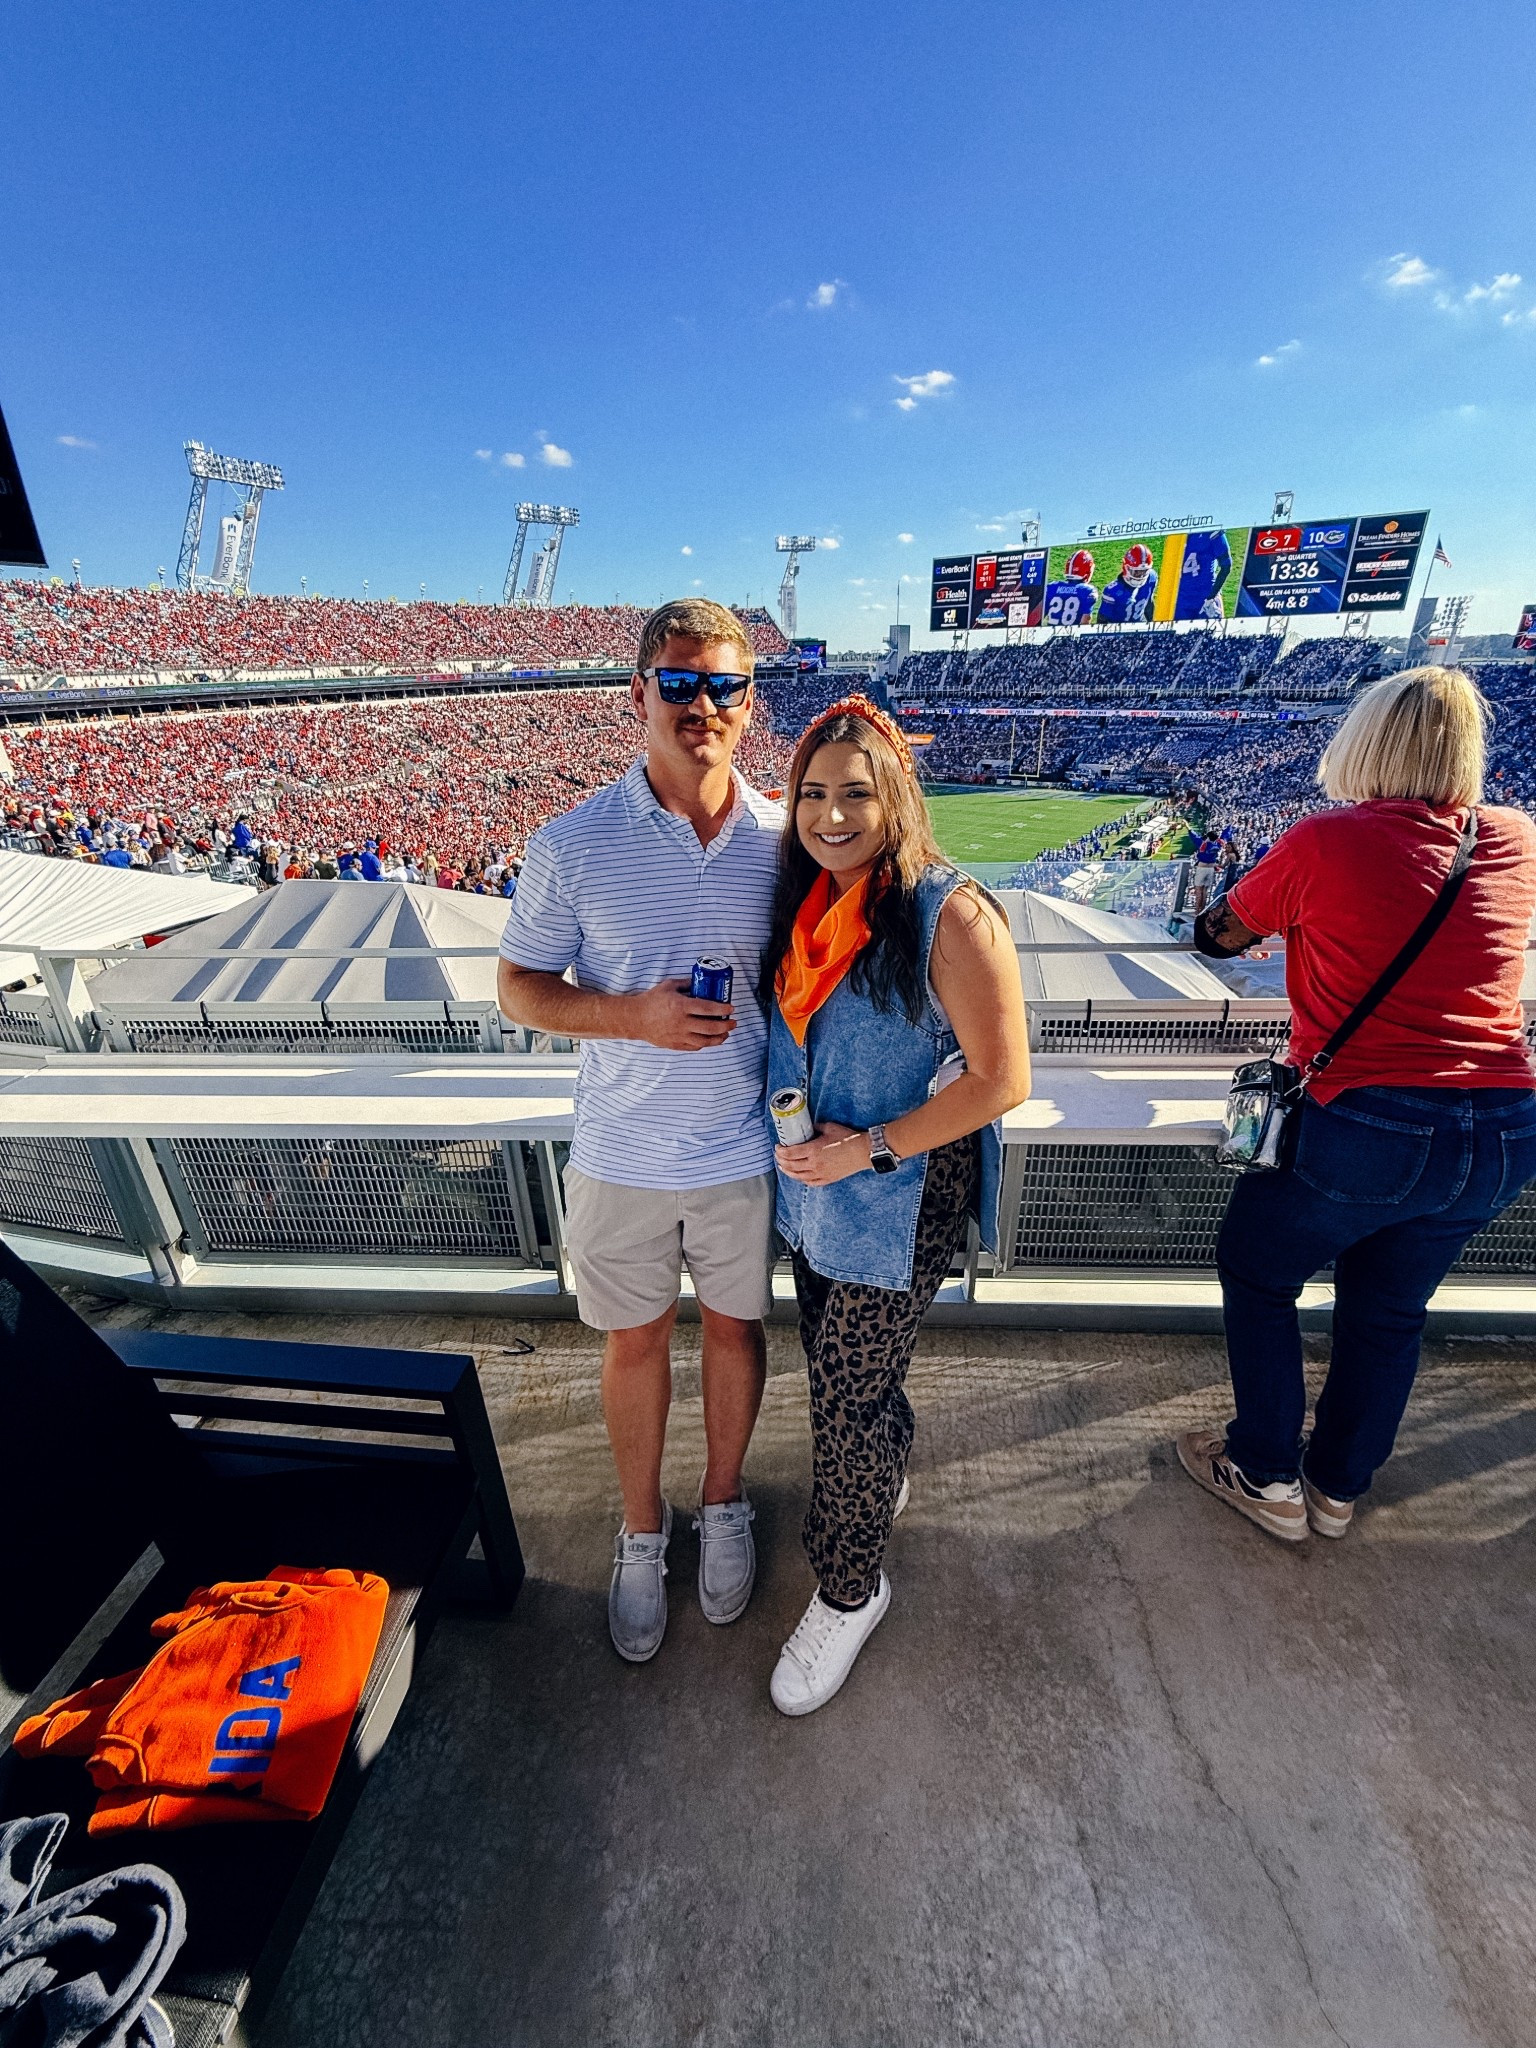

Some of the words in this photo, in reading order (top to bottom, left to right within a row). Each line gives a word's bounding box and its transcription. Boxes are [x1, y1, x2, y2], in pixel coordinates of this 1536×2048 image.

[1100, 519, 1157, 536] EverBank
[1159, 514, 1214, 530] Stadium
[1284, 534, 1292, 546] 7
[1309, 531, 1324, 544] 10
[1378, 532, 1400, 540] FINDERS
[220, 535, 236, 578] EverBank
[941, 565, 969, 574] EverBank
[1182, 552, 1200, 577] 4
[1270, 561, 1319, 581] 13:36
[1056, 586, 1078, 595] MOORE
[1359, 590, 1402, 602] Suddath
[1266, 596, 1285, 609] 4TH
[1286, 595, 1297, 608] &
[1299, 595, 1309, 608] 8
[1049, 597, 1080, 626] 28
[2, 693, 35, 702] EverBank
[55, 690, 87, 699] EverBank
[106, 687, 136, 696] EverBank
[1211, 1459, 1237, 1493] N
